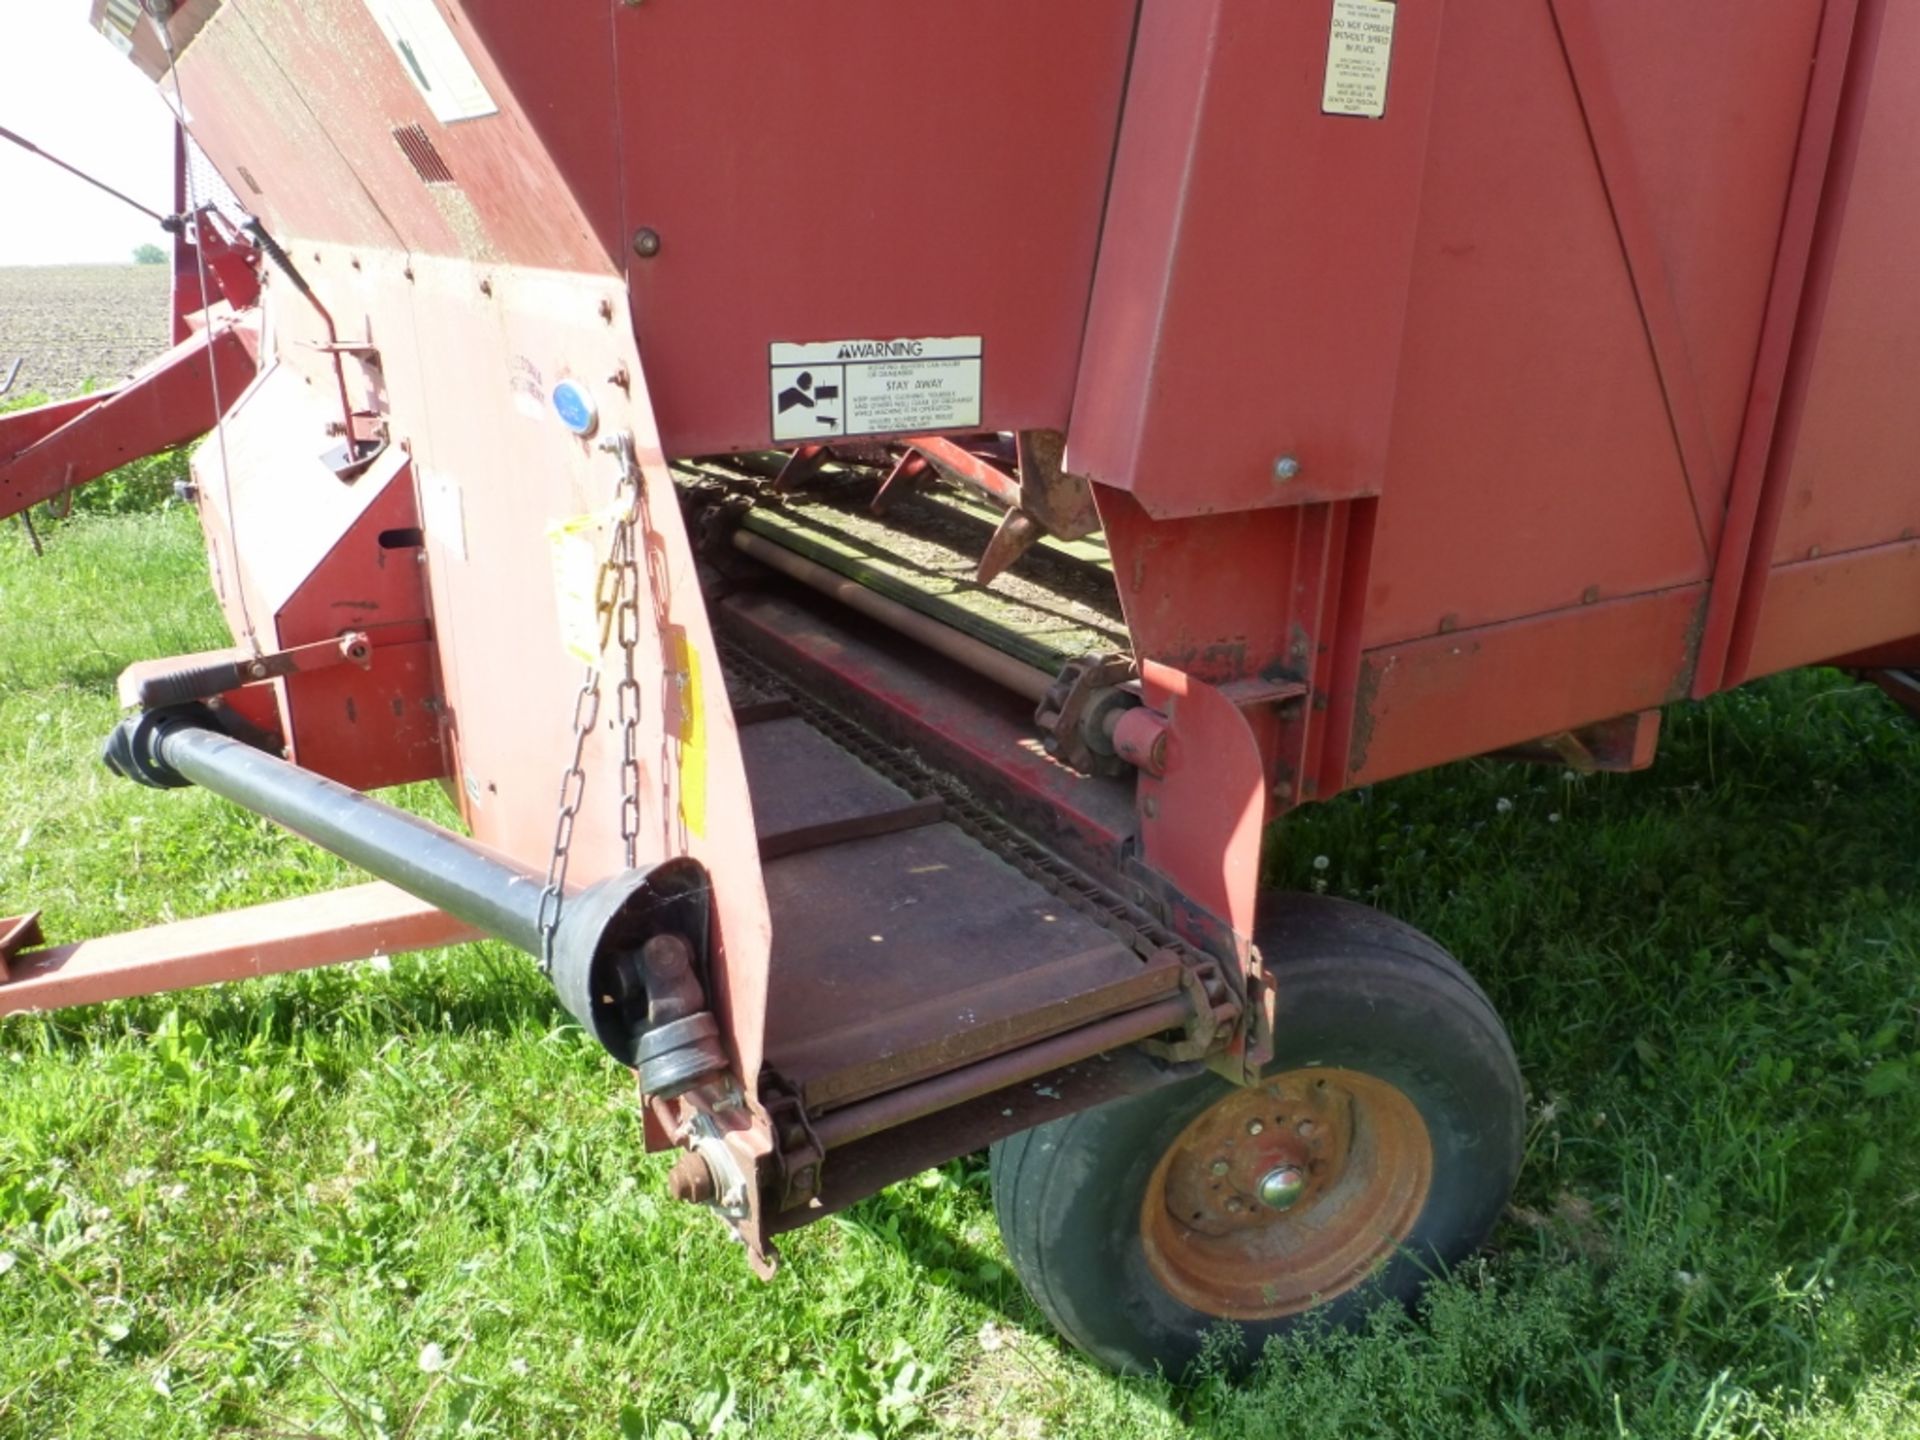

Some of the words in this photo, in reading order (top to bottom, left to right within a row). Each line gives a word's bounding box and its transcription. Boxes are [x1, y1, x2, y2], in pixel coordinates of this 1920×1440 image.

[1333, 18, 1345, 29] DO
[1347, 20, 1361, 30] NOT
[850, 341, 923, 358] WARNING
[885, 380, 910, 391] STAY
[914, 378, 944, 389] AWAY
